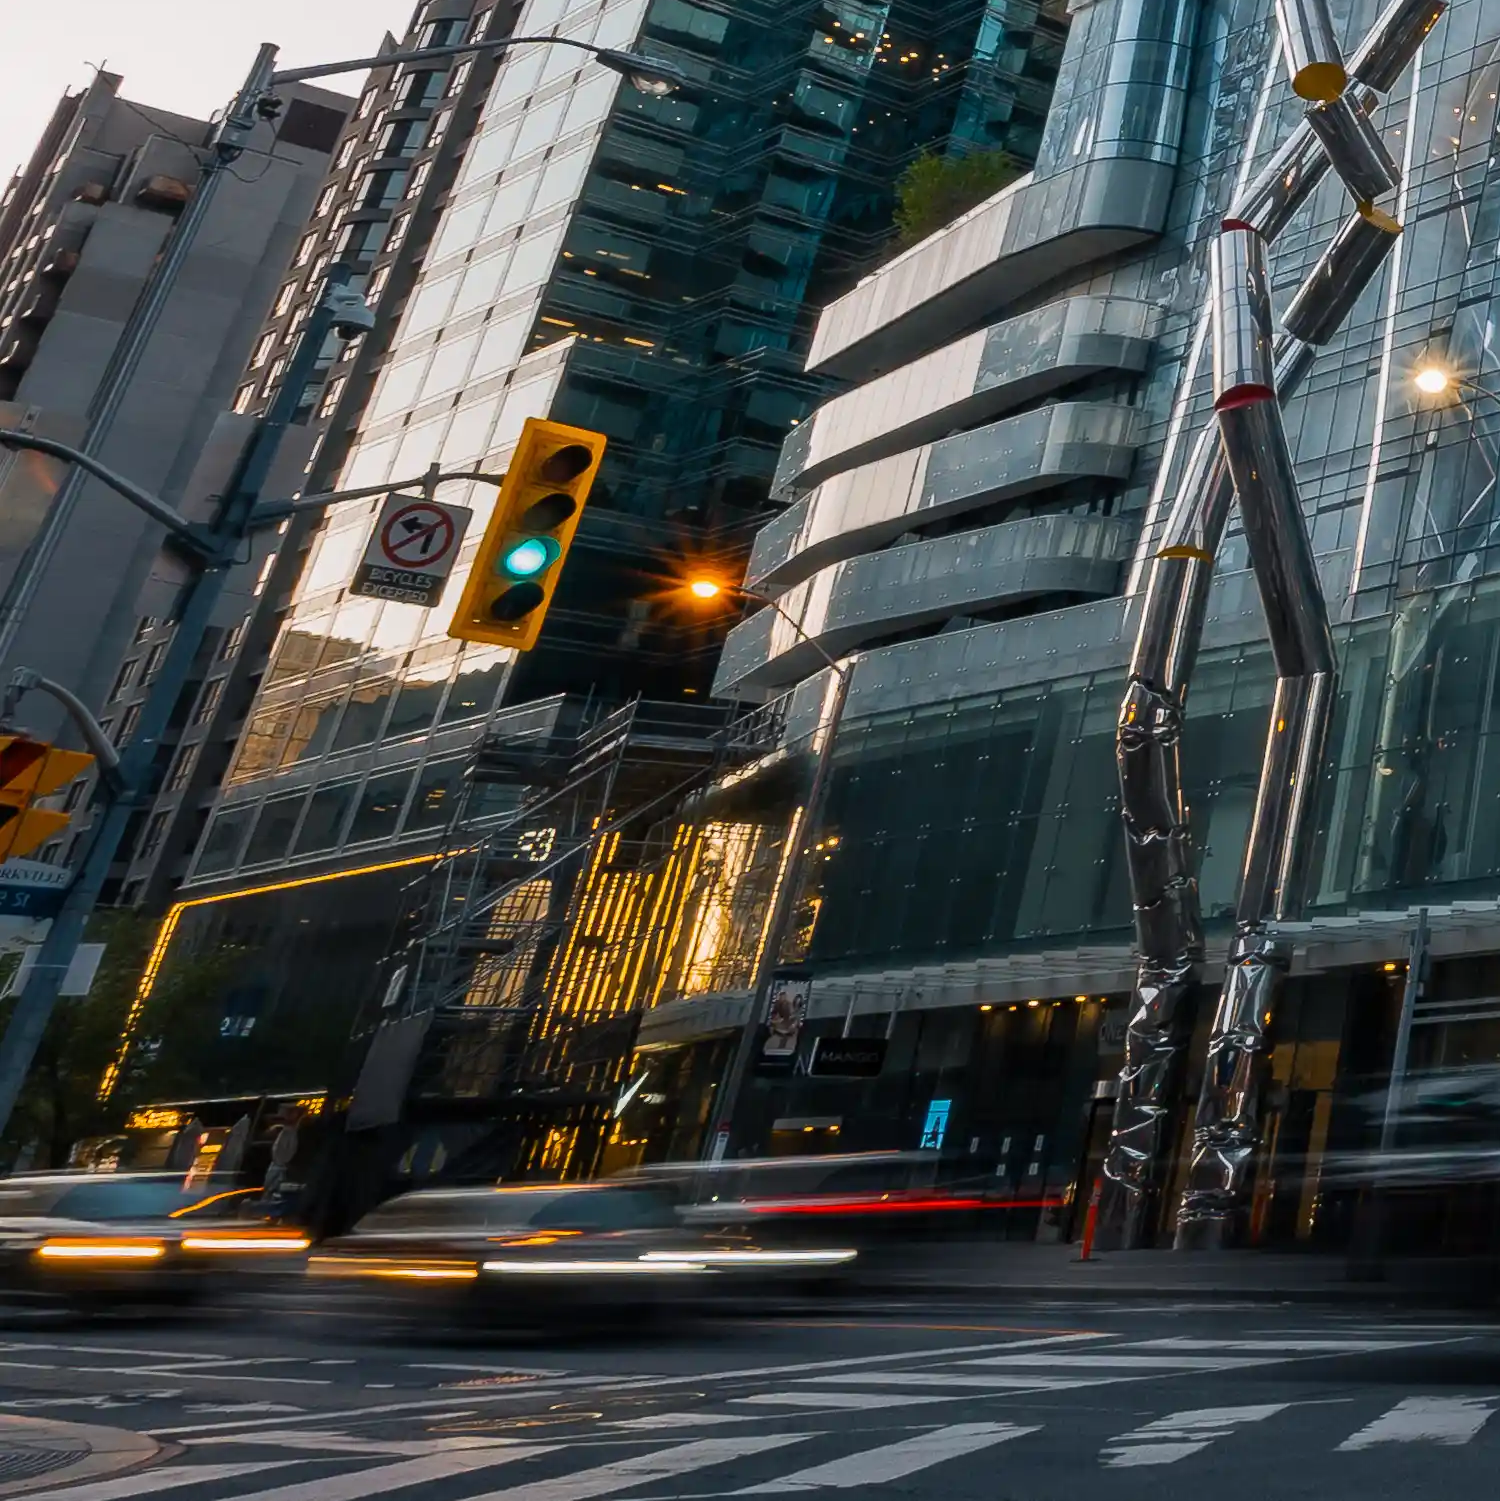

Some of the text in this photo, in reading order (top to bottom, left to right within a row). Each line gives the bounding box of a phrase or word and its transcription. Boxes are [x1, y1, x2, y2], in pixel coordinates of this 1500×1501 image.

[368, 566, 432, 590] BICYCLES
[361, 582, 429, 604] EXCEPTED
[0, 865, 66, 885] RKVILLE
